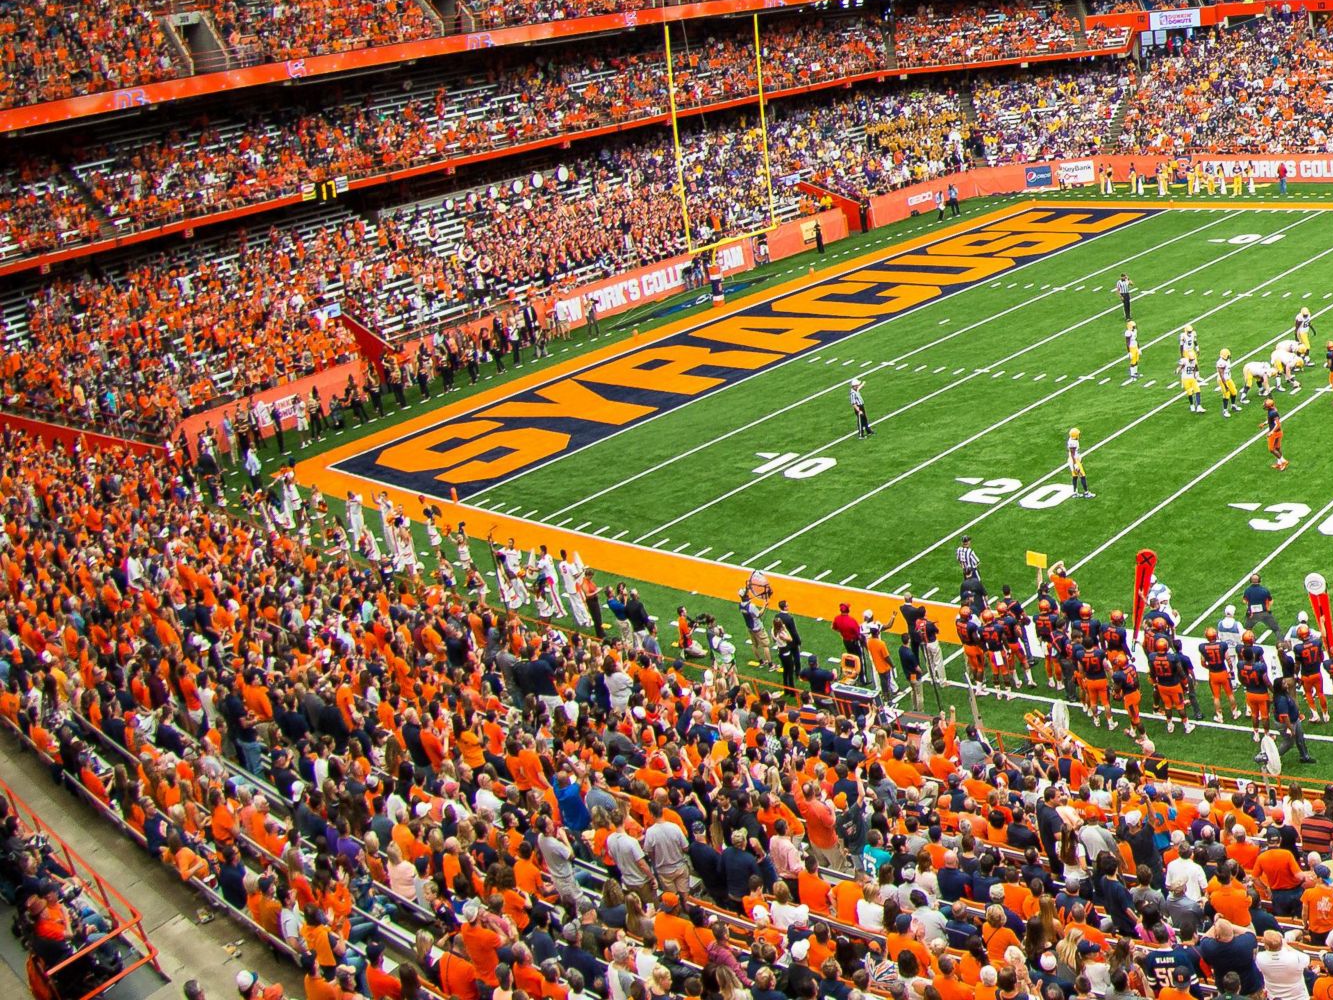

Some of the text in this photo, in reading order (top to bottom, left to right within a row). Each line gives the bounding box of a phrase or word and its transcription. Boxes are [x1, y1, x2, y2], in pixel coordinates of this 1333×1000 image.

[376, 206, 1149, 484] SYRACUSE
[751, 452, 838, 479] 10
[958, 478, 1077, 509] 20
